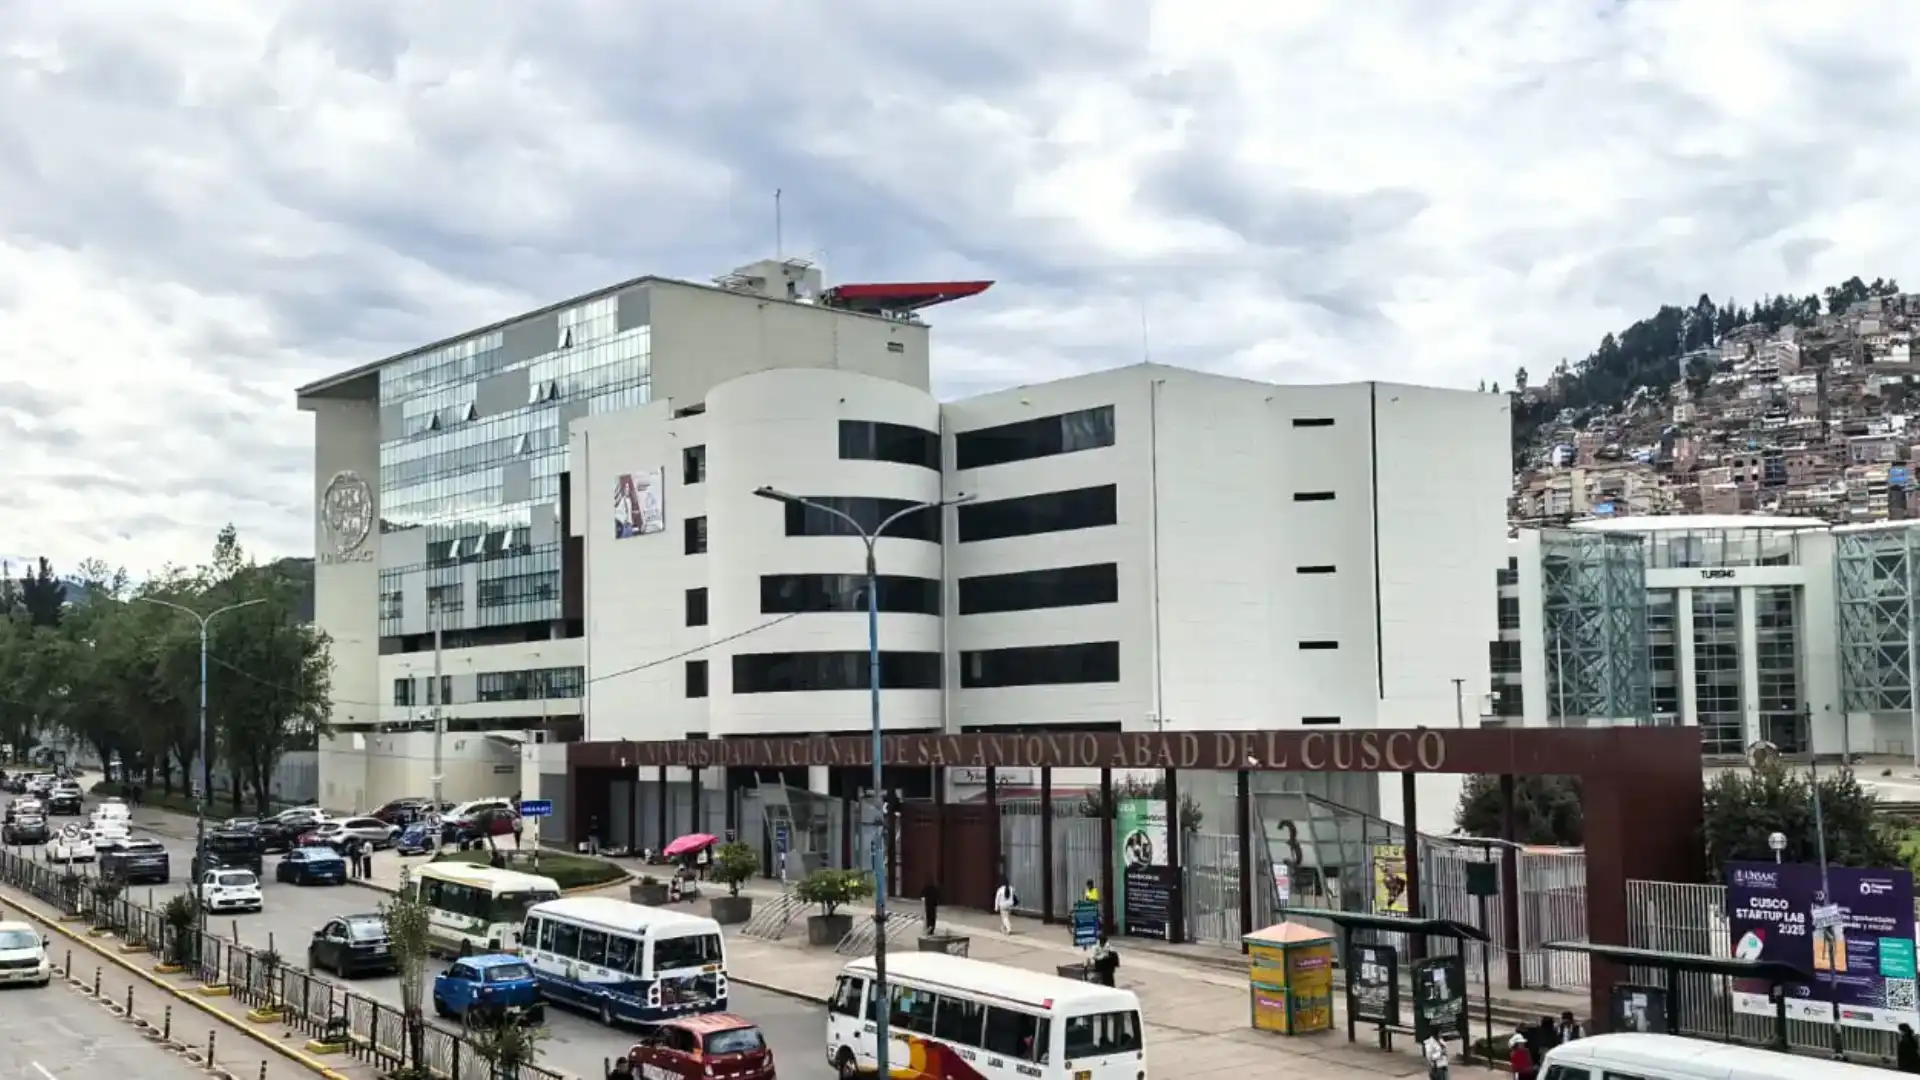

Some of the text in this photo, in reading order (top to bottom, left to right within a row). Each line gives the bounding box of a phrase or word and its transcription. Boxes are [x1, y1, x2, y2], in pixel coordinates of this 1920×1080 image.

[633, 730, 1446, 770] UNIVERSIDAD NACIONAL DE SAN ANTONIO ABAD DEL CUSCO
[1750, 897, 1789, 910] CUSCO
[1736, 908, 1805, 923] STARTUP LAB
[1778, 923, 1805, 935] 2025
